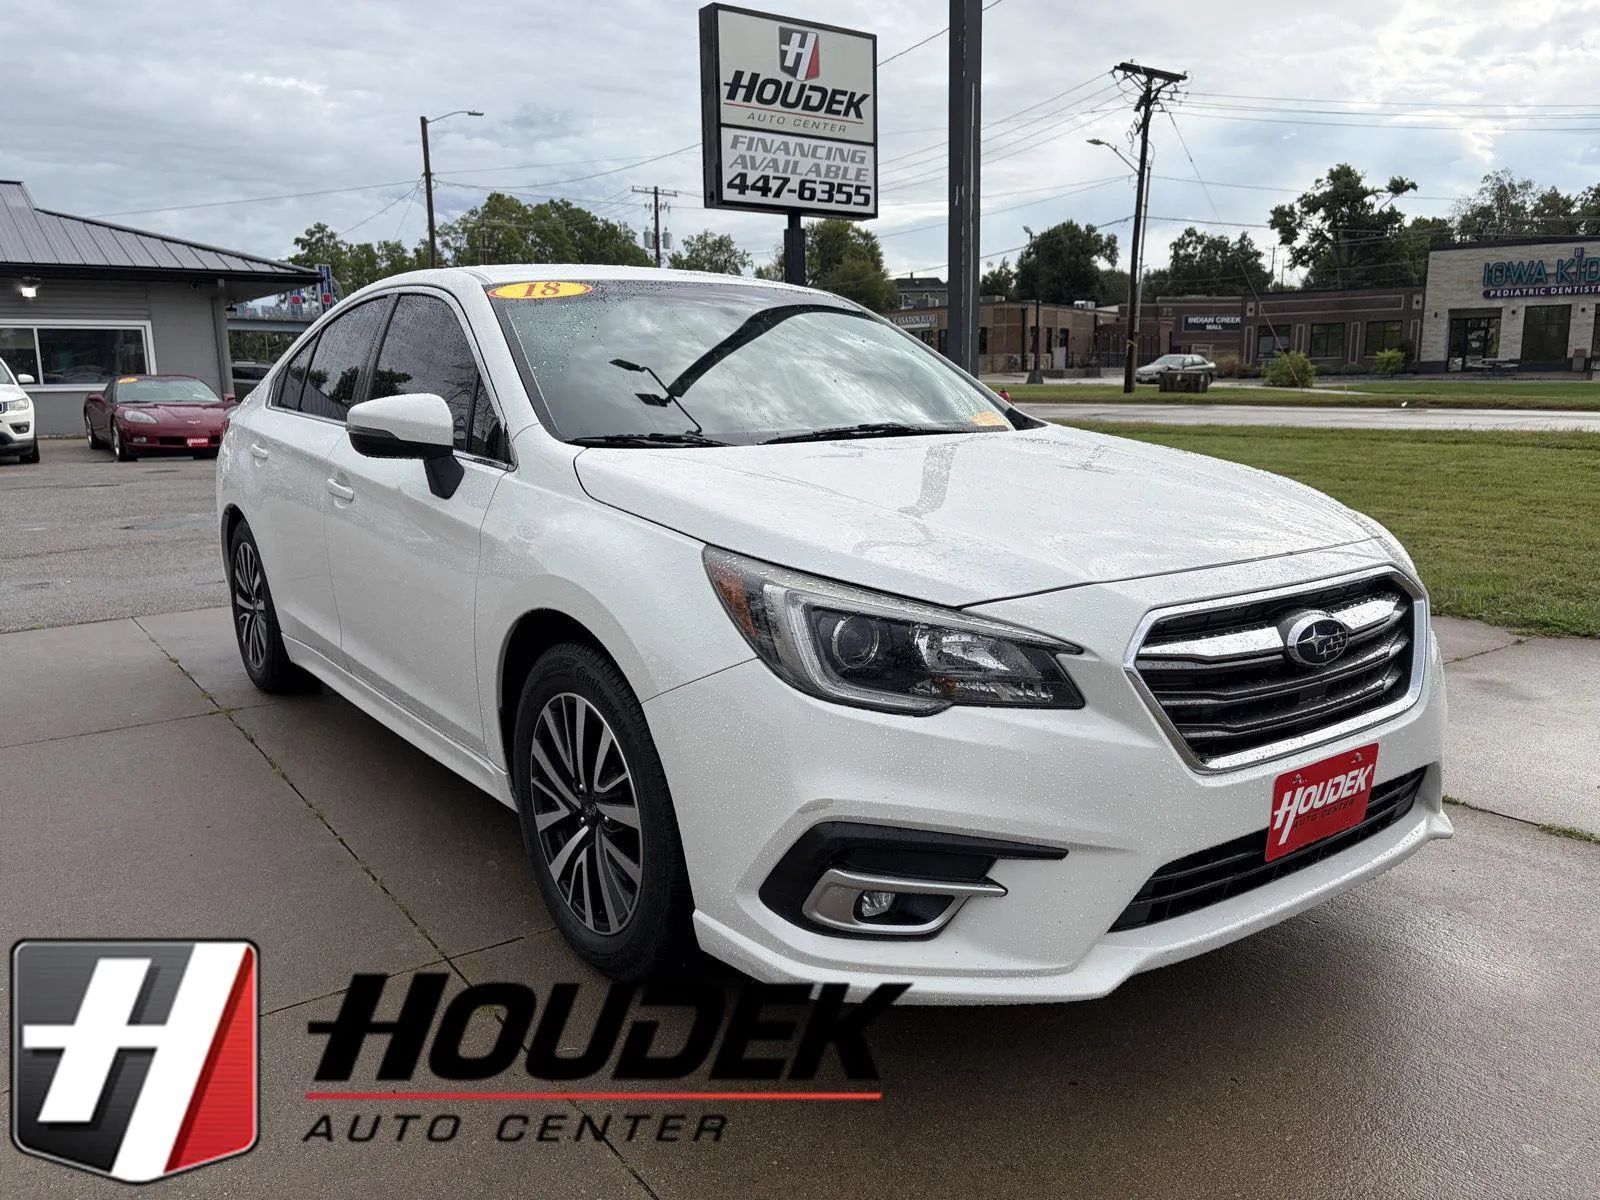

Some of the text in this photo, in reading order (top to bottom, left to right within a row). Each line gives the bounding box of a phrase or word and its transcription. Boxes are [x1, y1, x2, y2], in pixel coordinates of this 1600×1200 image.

[723, 69, 870, 119] HOUDEK
[746, 112, 847, 133] AUTO CENTER
[730, 134, 867, 165] FINANCING
[728, 153, 869, 183] AVAILABLE
[726, 172, 872, 207] 447-6355
[1483, 260, 1548, 287] IOWA
[523, 282, 561, 298] 18
[1489, 288, 1546, 297] PEDIATRIC
[1188, 316, 1241, 324] INDIAN CREEK
[1273, 763, 1374, 847] HOUDEK
[1295, 799, 1354, 828] AUTO CENTER
